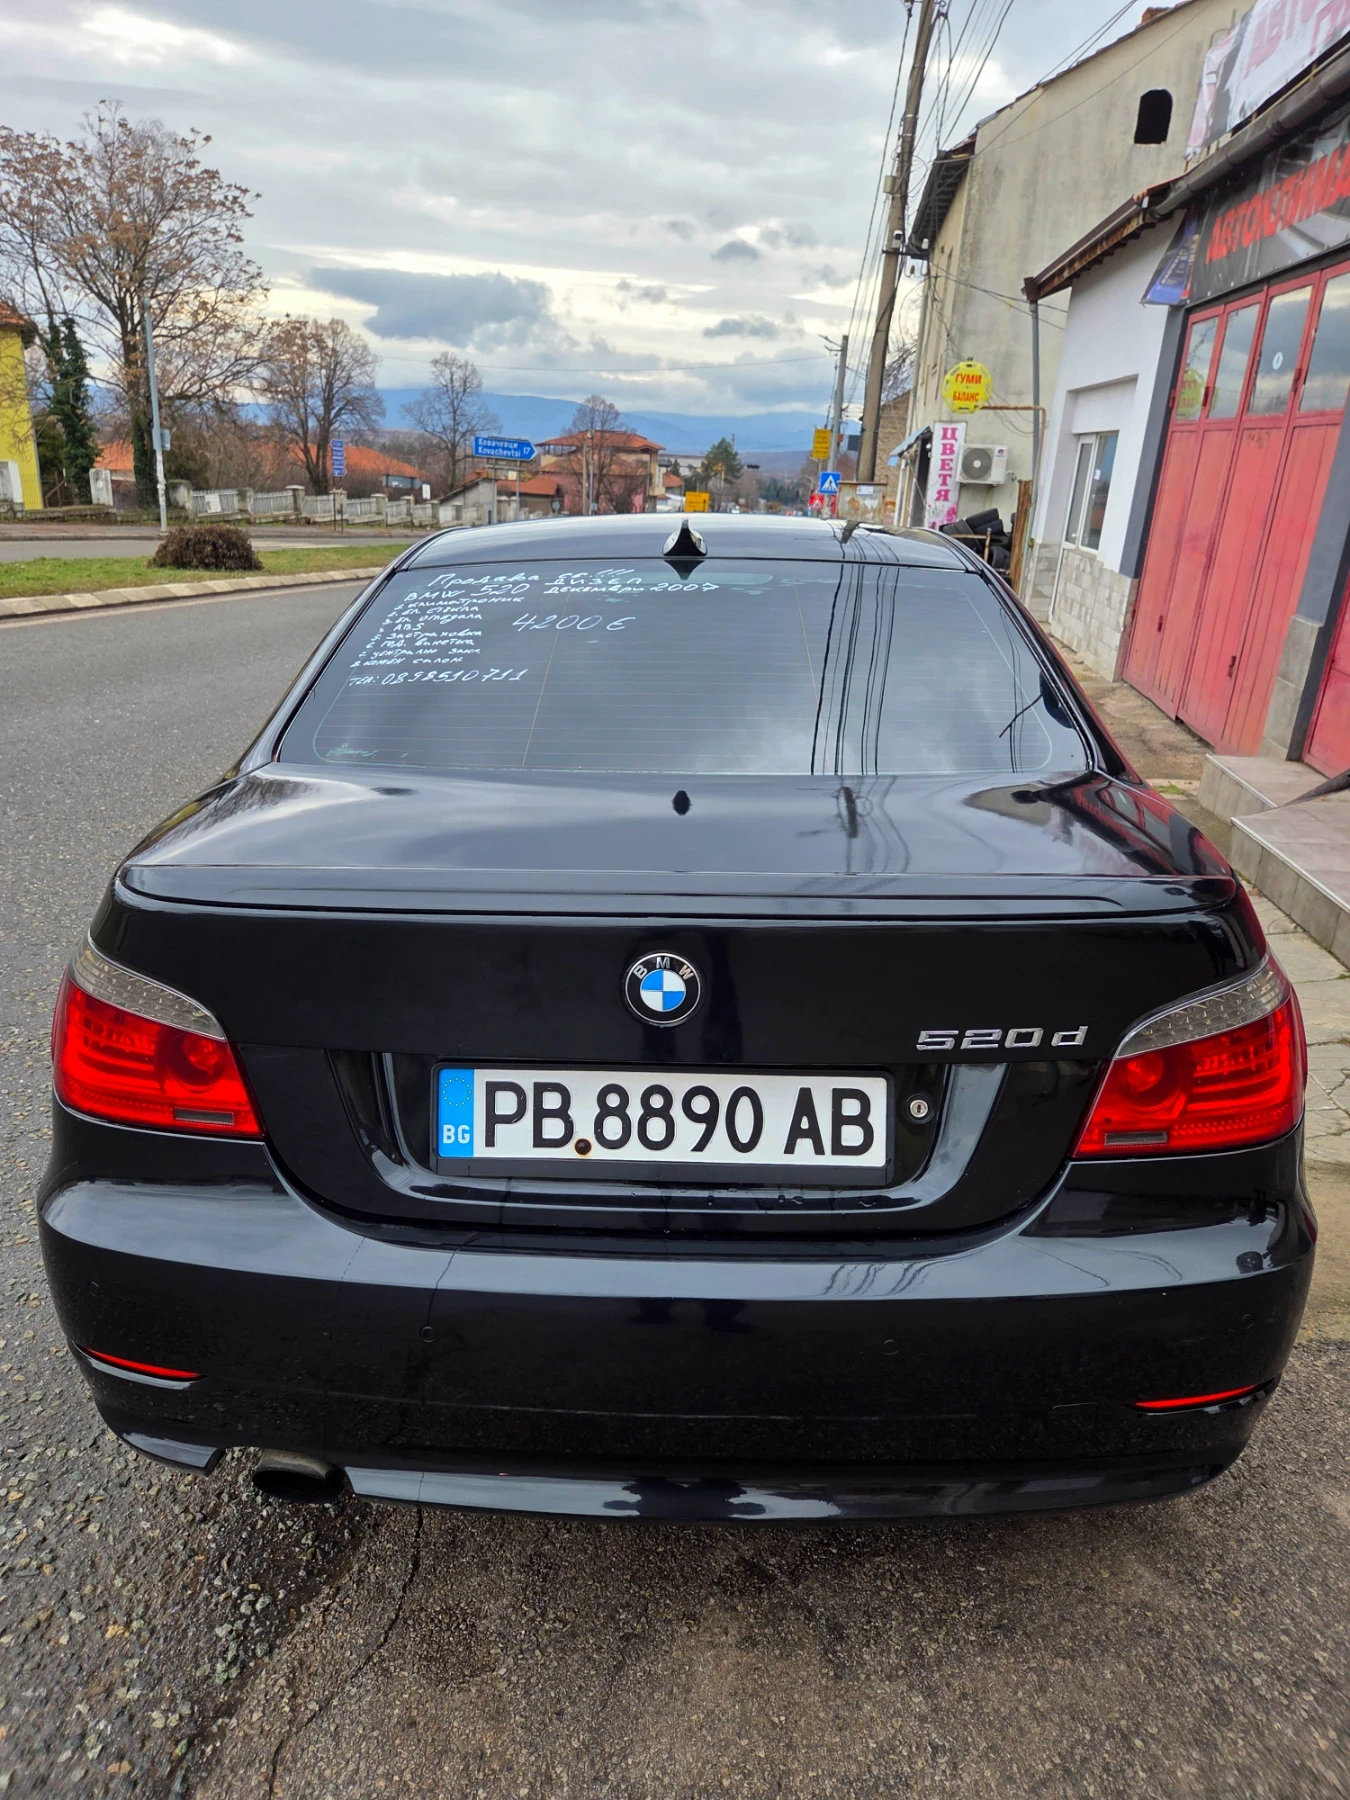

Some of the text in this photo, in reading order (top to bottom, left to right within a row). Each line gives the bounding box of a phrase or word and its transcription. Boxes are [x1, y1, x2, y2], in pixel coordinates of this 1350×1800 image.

[955, 373, 982, 385] ГУМИ
[952, 391, 980, 403] БАЛАНС
[478, 439, 518, 449] Ковачевци
[478, 447, 521, 457] Kovachevtsi
[523, 446, 531, 455] 17
[935, 427, 958, 502] ЦВЕТЯ
[427, 572, 540, 590] Продава
[649, 582, 720, 593] 2007
[403, 590, 466, 602] BMW
[470, 583, 531, 596] 520
[511, 613, 603, 632] 4200
[632, 956, 695, 980] BMW
[484, 1080, 875, 1156] PB 8890 AB
[442, 1124, 471, 1144] BG
